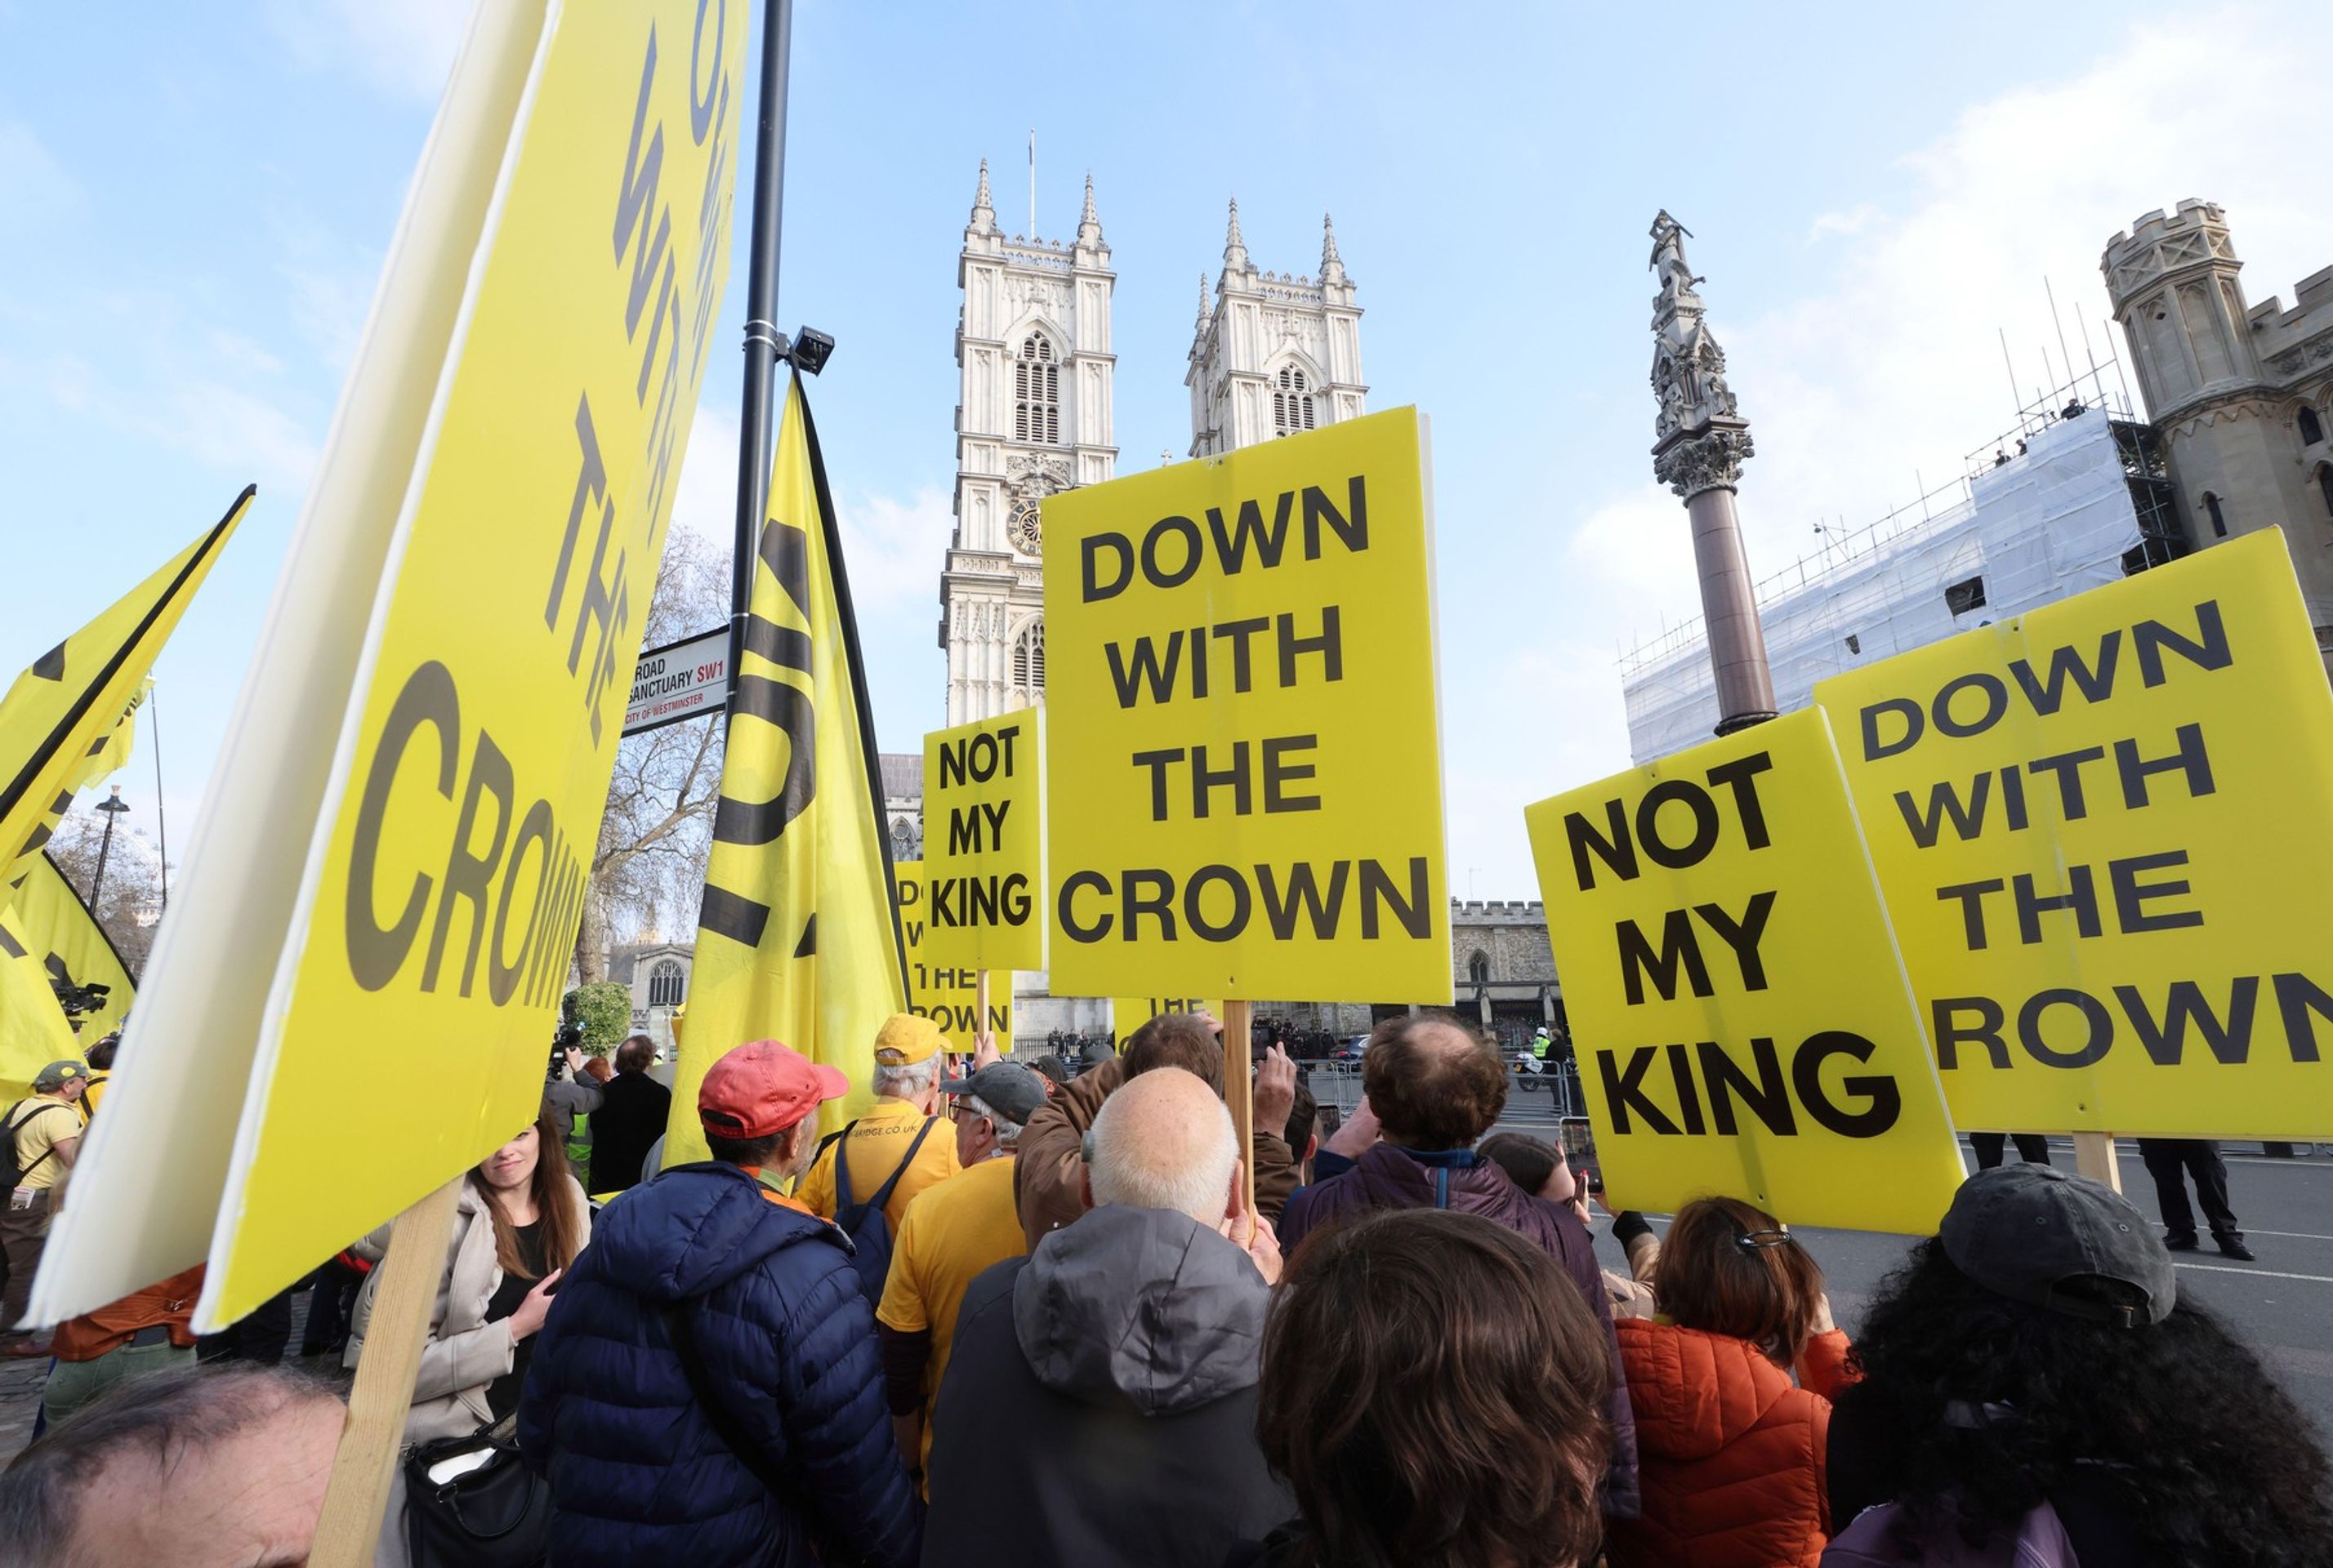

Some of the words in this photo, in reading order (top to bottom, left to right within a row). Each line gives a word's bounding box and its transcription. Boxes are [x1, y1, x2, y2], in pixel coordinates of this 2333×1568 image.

[613, 15, 680, 552] WITH
[544, 388, 628, 753] THE
[1082, 474, 1368, 604] DOWN
[635, 658, 666, 683] ROAD
[697, 660, 723, 683] SW1
[1104, 605, 1343, 709] WITH
[1860, 599, 2233, 762] DOWN
[624, 712, 640, 725] CITY
[641, 707, 653, 719] OF
[653, 693, 703, 716] WESTMINSTER
[939, 725, 1019, 790] NOT
[949, 800, 1011, 857] MY
[1132, 734, 1321, 822] THE
[1564, 751, 1773, 891] NOT
[1894, 722, 2216, 849] WITH
[345, 660, 586, 1010] CROWN
[931, 873, 1032, 928] KING
[1058, 857, 1431, 943] CROWN
[1615, 890, 1778, 1006] MY
[1936, 849, 2205, 951] THE
[914, 963, 978, 990] THE
[1931, 972, 2333, 1071] ROWN
[1595, 1031, 1902, 1138] KING
